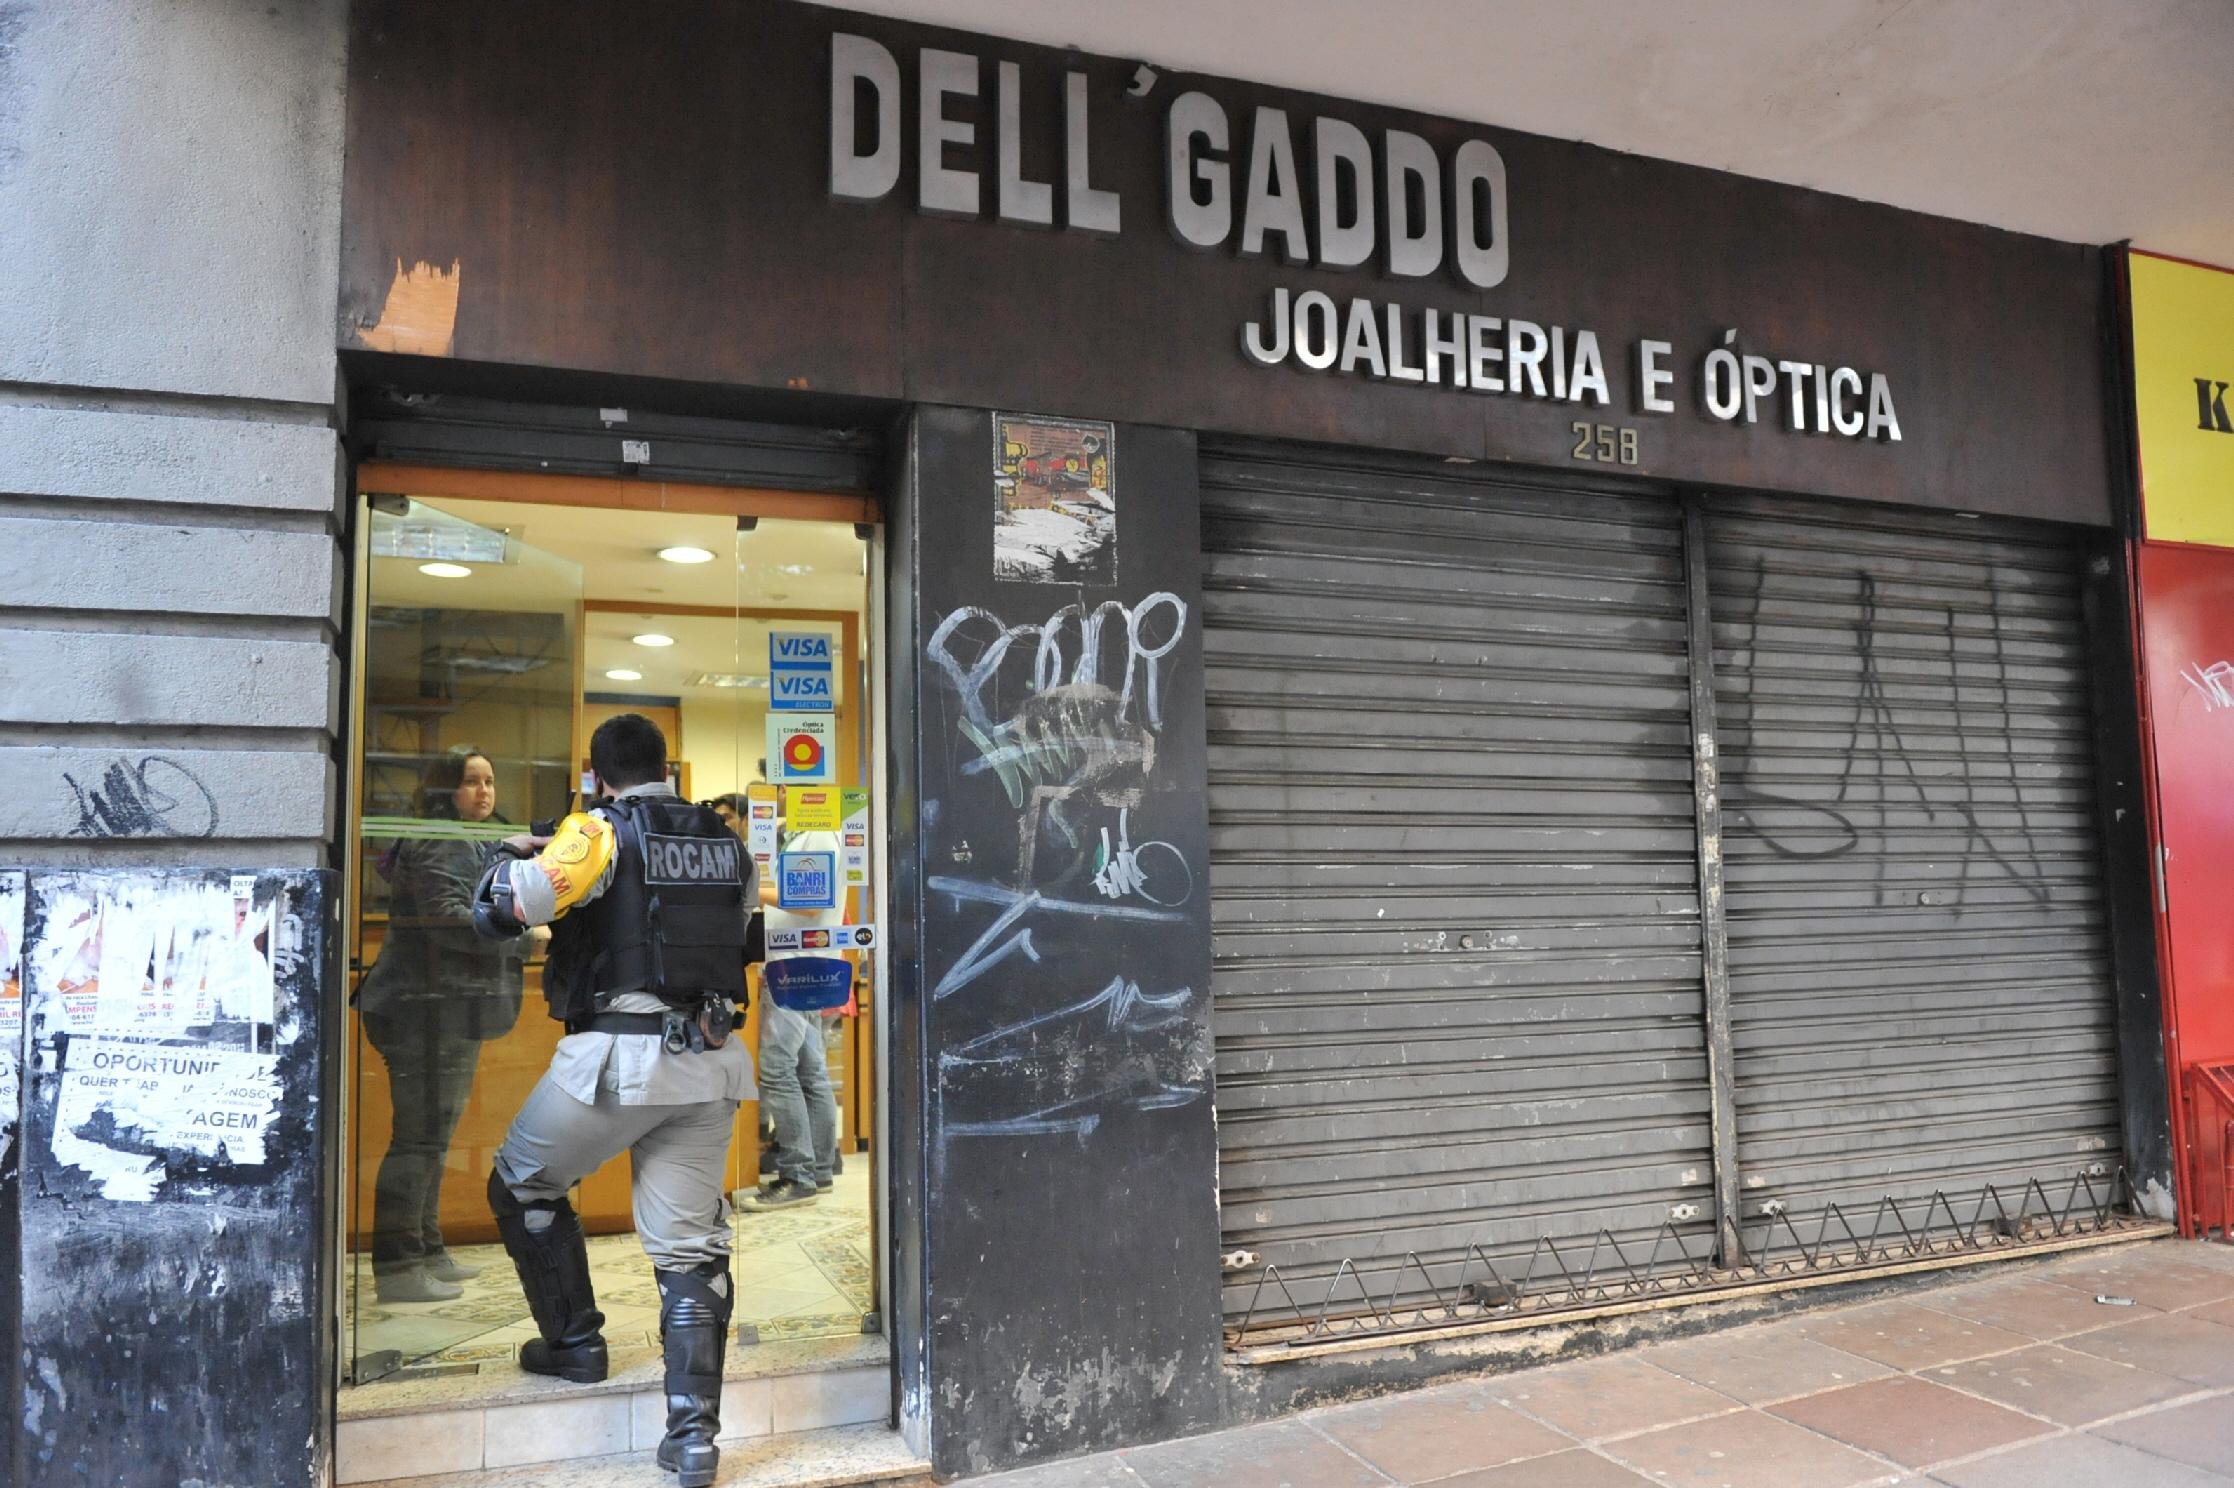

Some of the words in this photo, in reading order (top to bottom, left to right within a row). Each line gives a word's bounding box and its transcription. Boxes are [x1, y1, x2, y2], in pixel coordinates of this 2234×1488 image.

[1243, 287, 1610, 404] JOALHERIA
[1637, 339, 1674, 413] E
[1705, 328, 1902, 441] ÓPTICA
[1571, 420, 1638, 465] 258
[778, 638, 828, 657] VISA
[778, 677, 829, 695] VISA
[649, 841, 736, 880] ROCAM
[786, 871, 826, 887] BANRI
[786, 886, 826, 897] COMPRAS
[772, 933, 797, 943] VISA
[79, 1075, 118, 1087] QUER
